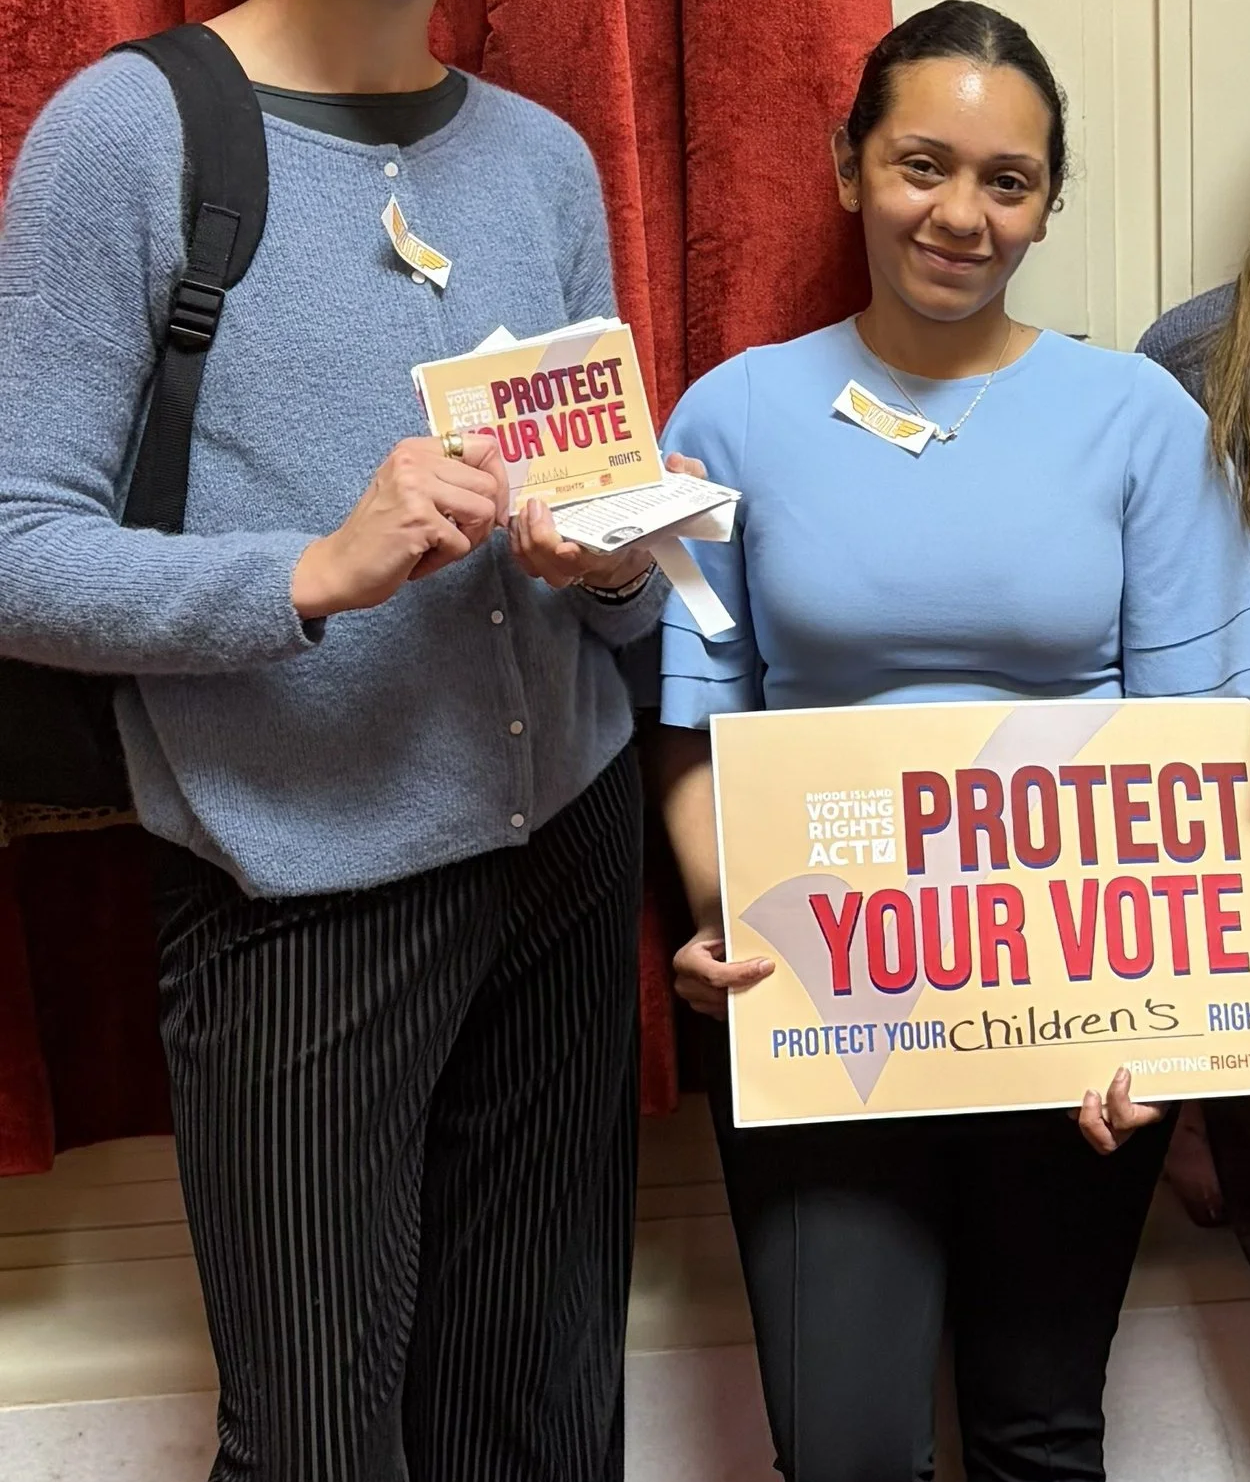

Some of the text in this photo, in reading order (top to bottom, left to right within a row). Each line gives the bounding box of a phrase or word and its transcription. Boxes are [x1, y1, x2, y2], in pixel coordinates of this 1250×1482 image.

[491, 358, 624, 419] PROTECT
[546, 401, 632, 453] VOTE
[608, 450, 642, 467] RIGHTS
[805, 788, 894, 802] RHODE ISLAND
[807, 798, 894, 821] VOTING
[808, 817, 896, 839] RIGHTS
[901, 762, 1249, 876] PROTECT
[808, 840, 870, 867] ACT
[808, 873, 1250, 996] YOUR VOTE
[772, 1023, 877, 1059] PROTECT
[884, 1020, 946, 1052] YOUR
